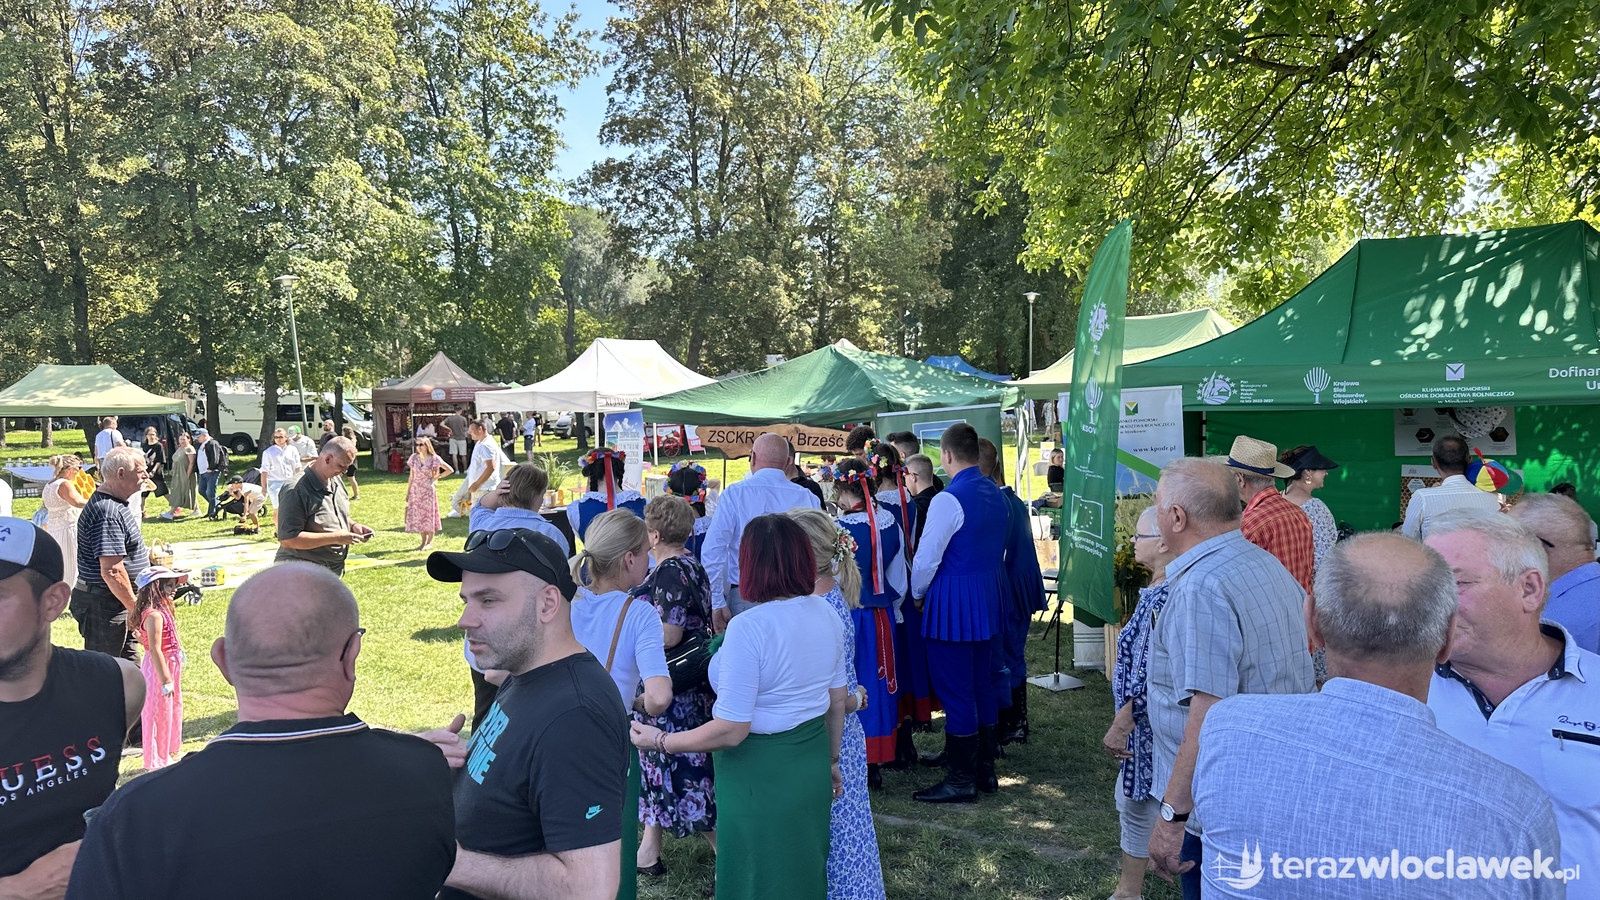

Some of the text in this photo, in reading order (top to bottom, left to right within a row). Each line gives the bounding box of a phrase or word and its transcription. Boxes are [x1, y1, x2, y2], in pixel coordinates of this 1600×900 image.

[708, 430, 755, 444] ZSCKR
[797, 433, 844, 447] Brześć
[0, 736, 106, 791] UESS
[0, 768, 88, 806] OS ANGELES
